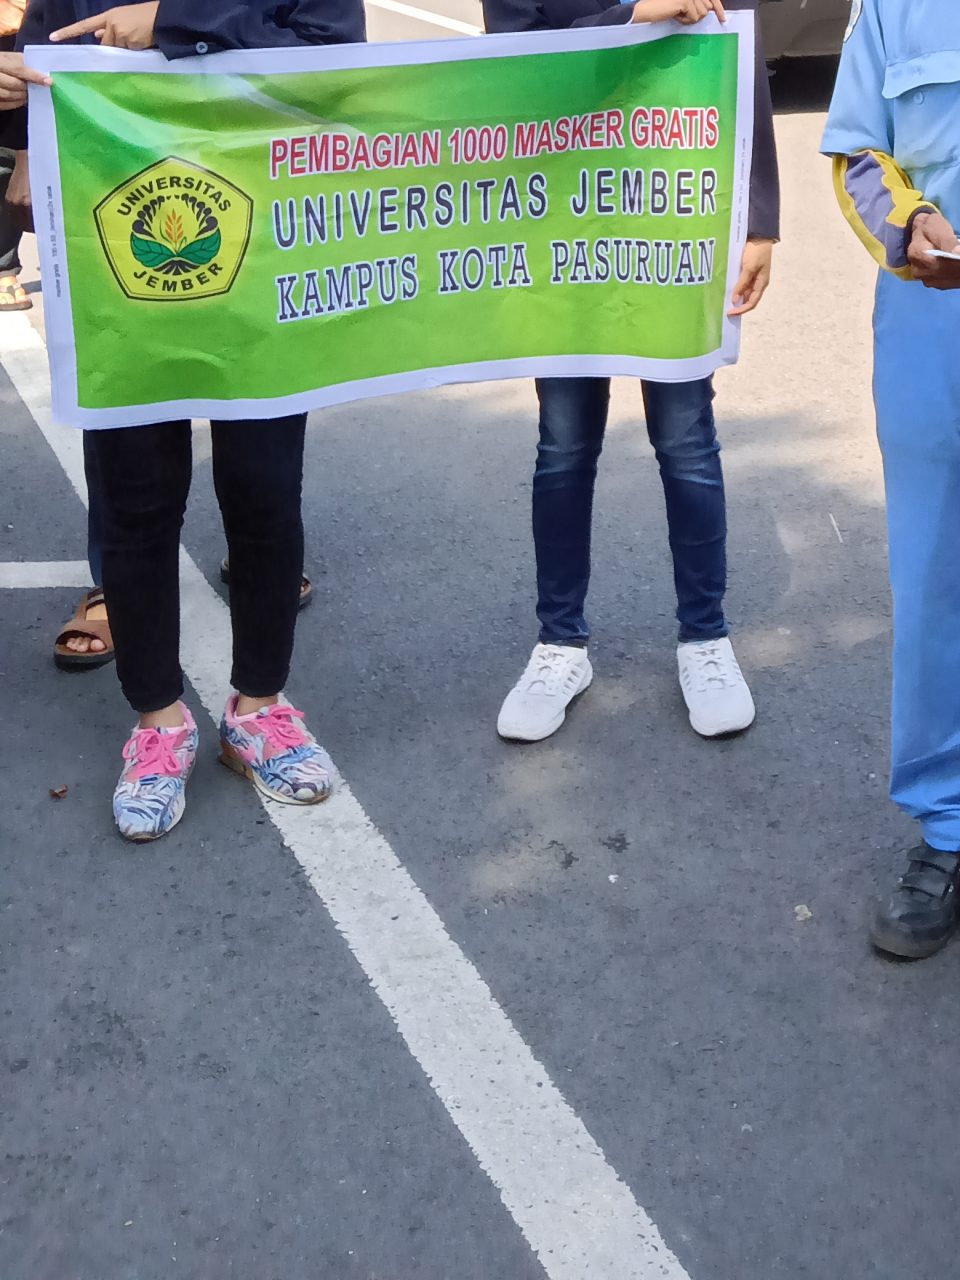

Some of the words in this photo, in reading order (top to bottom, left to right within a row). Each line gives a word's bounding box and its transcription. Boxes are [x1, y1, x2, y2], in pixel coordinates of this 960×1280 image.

[271, 129, 441, 178] PEMBAGIAN
[449, 124, 507, 164] 1000
[514, 109, 625, 157] MASKER
[631, 107, 719, 148] GRATIS
[117, 176, 231, 216] UNIVERSITAS
[273, 173, 548, 248] UNIVERSITAS
[572, 169, 717, 215] JEMBER
[133, 262, 223, 292] JEMBER
[276, 255, 418, 321] KAMPUS
[439, 243, 531, 292] KOTA
[551, 238, 716, 284] PASURUAN
